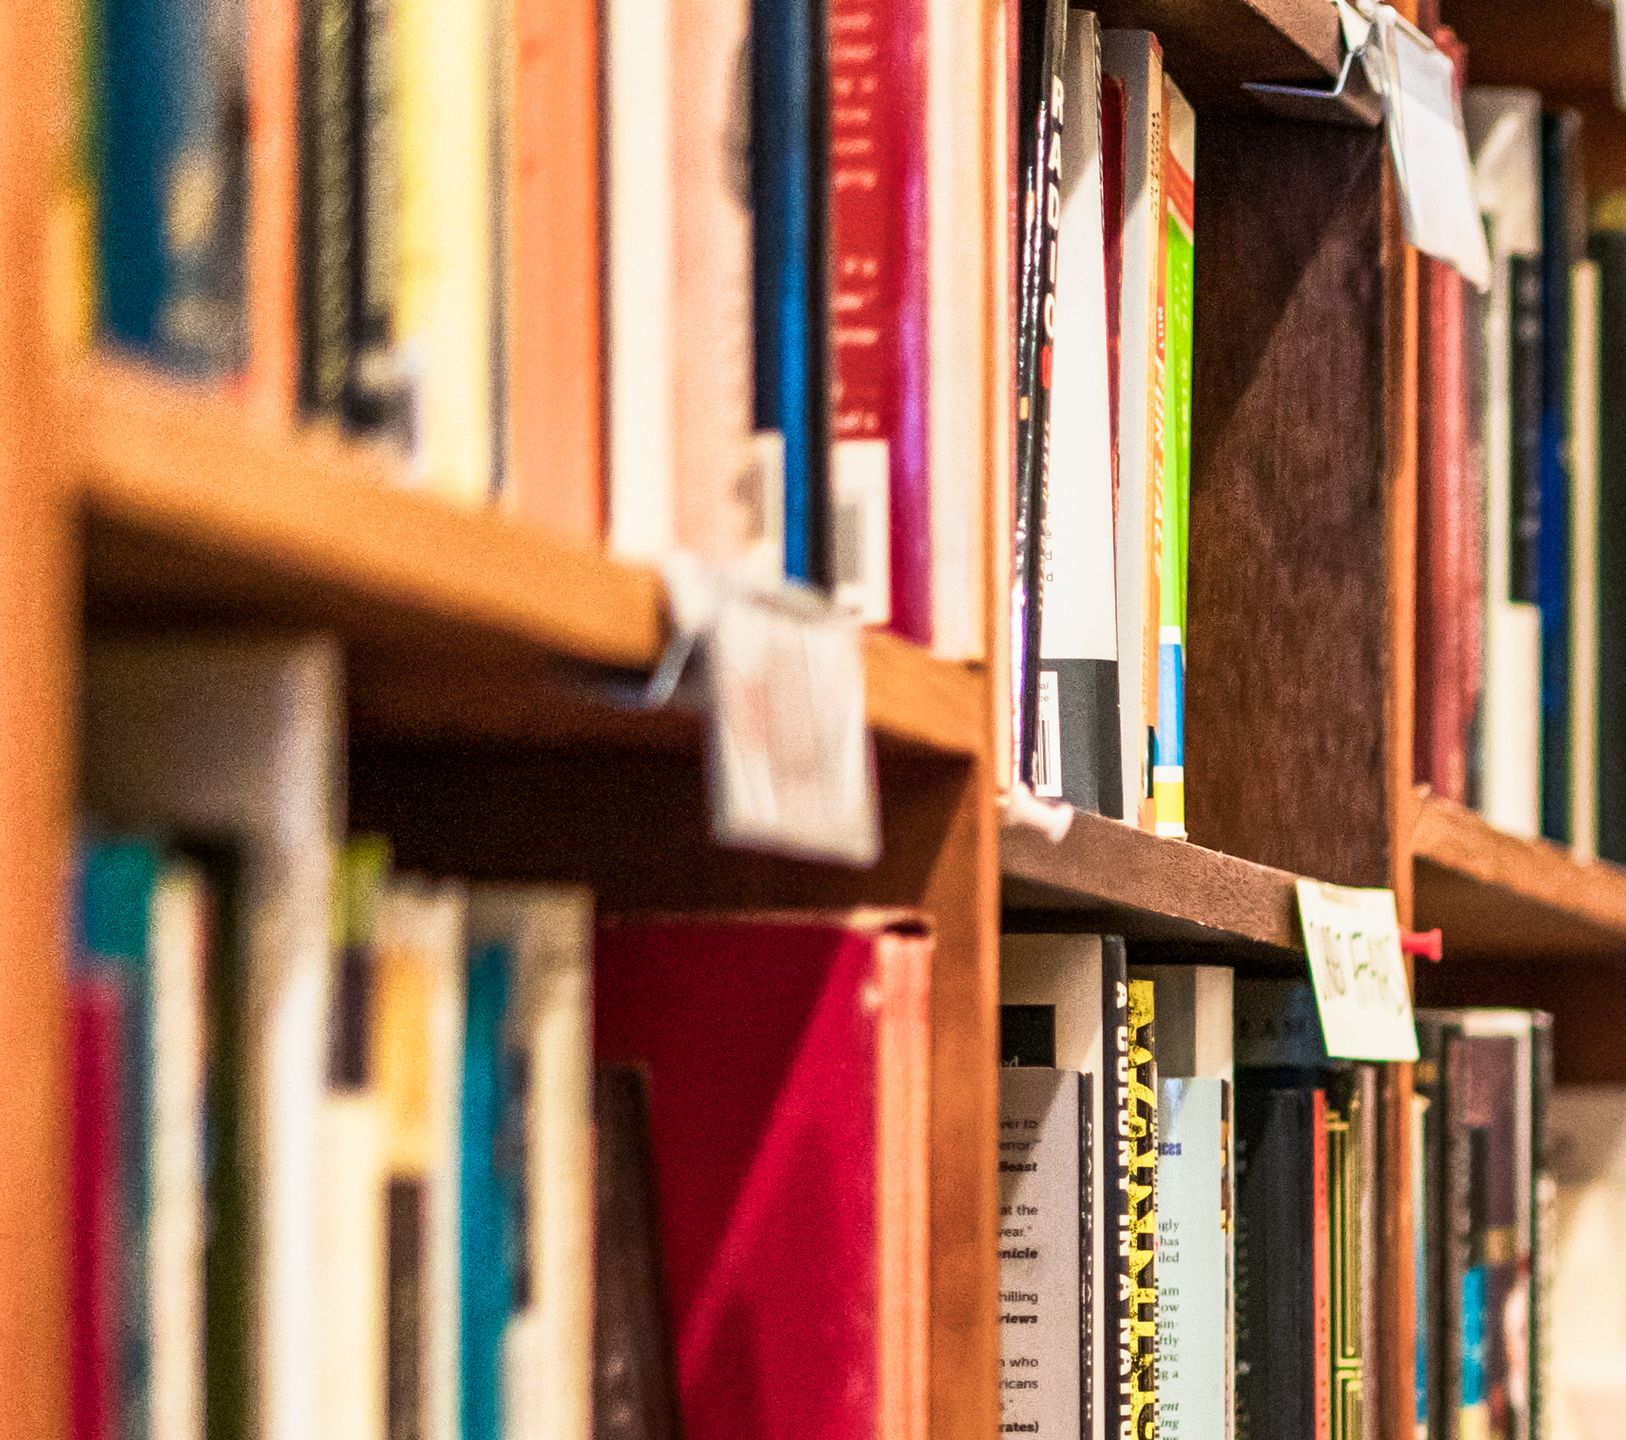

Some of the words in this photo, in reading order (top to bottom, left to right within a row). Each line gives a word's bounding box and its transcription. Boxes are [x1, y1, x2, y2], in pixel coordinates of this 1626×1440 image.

[1043, 73, 1065, 338] RADIO
[1114, 981, 1127, 1008] A
[1115, 1026, 1131, 1192] COLONY
[1016, 1203, 1039, 1216] the
[1118, 1213, 1131, 1257] IN
[998, 1247, 1039, 1259] nicle
[1010, 1355, 1039, 1368] who
